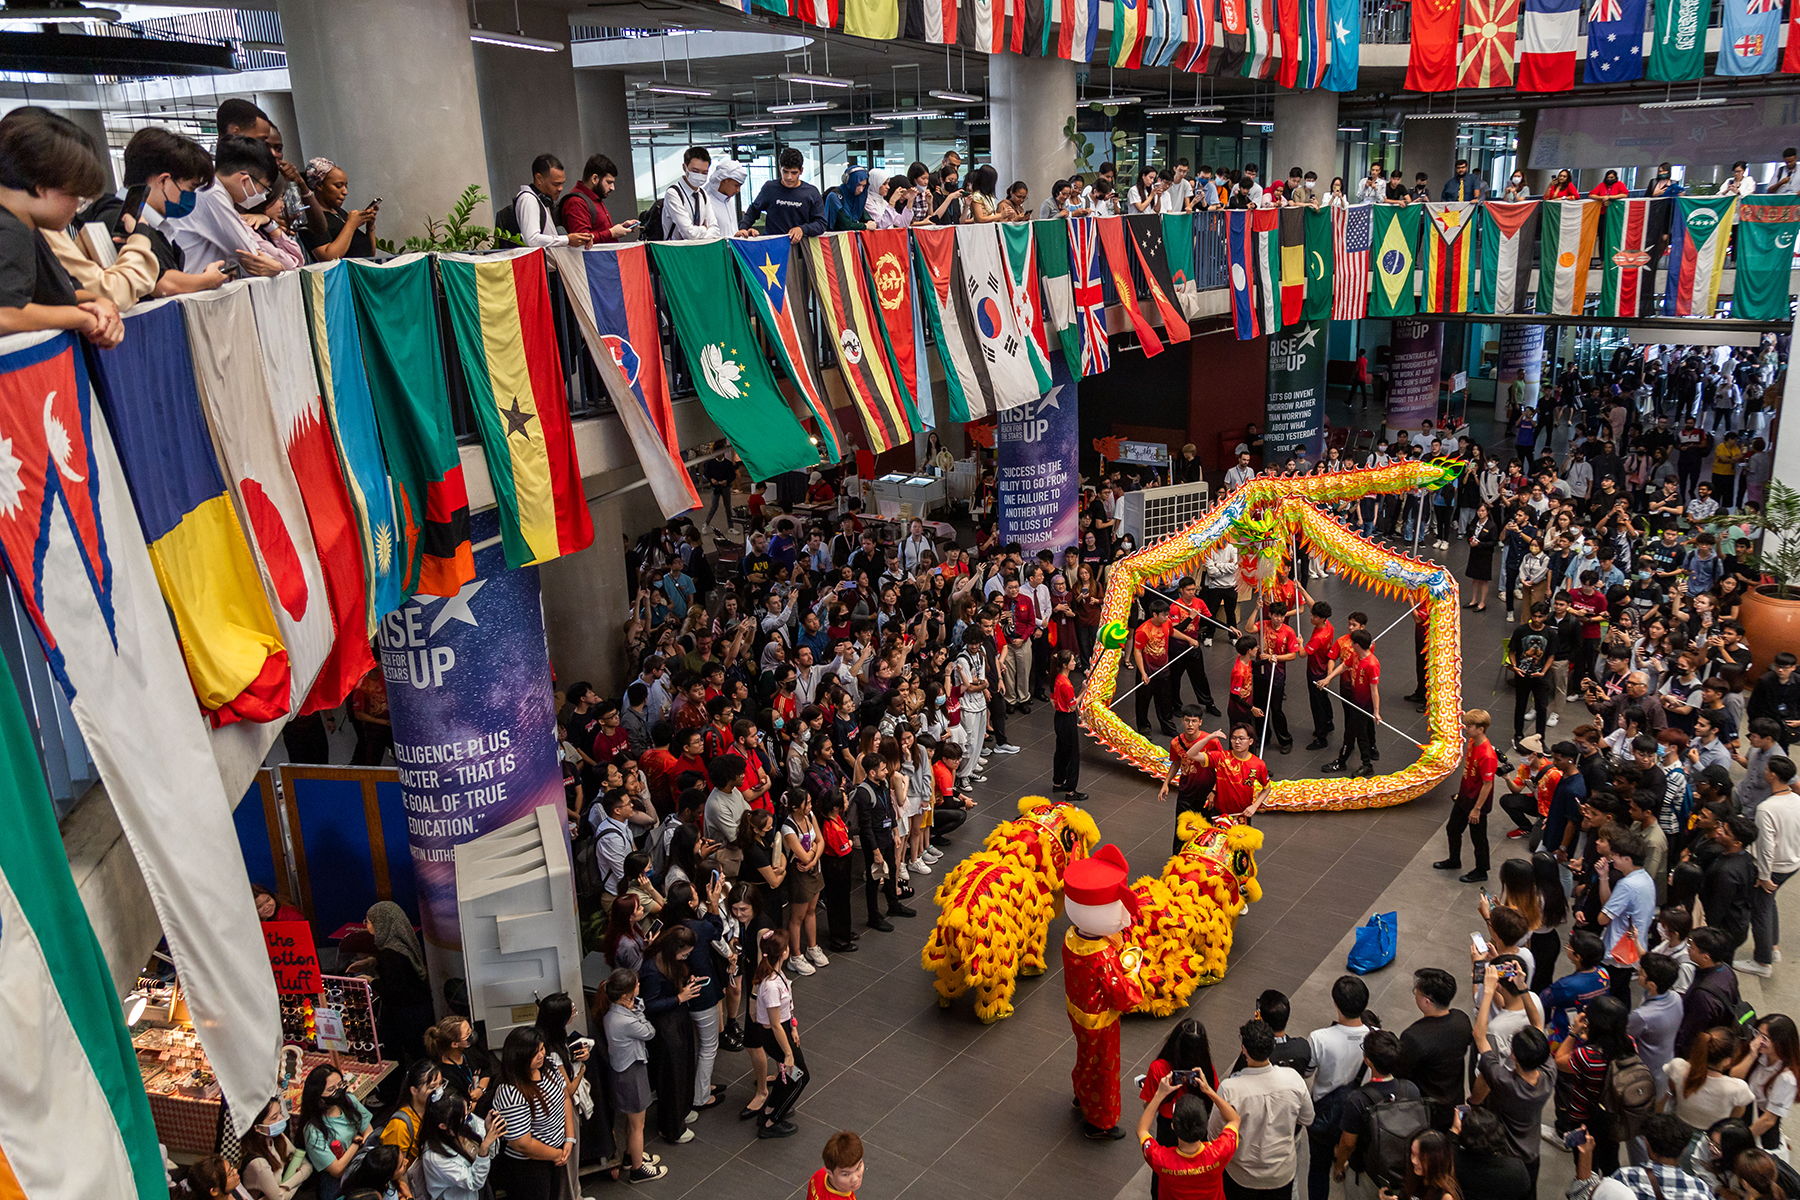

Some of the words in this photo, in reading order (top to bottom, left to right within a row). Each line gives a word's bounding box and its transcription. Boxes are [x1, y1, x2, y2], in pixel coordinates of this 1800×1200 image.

[1412, 324, 1429, 340] UP
[1270, 338, 1297, 357] RISE
[1287, 354, 1306, 371] UP
[1293, 388, 1314, 399] INVENT
[1295, 398, 1316, 409] RATHER
[1001, 403, 1034, 423] RISE
[1281, 409, 1312, 421] WORRYING
[1023, 419, 1048, 443] UP
[1272, 423, 1289, 431] ABOUT
[1290, 420, 1306, 430] WHAT
[1038, 464, 1046, 474] IS
[1048, 460, 1062, 472] THE
[1022, 480, 1031, 490] TO
[1033, 478, 1044, 489] GO
[1046, 472, 1067, 487] FROM
[1004, 494, 1016, 505] ONE
[1017, 491, 1049, 504] FAILURE
[1051, 488, 1060, 499] TO
[1005, 506, 1036, 518] ANOTHER
[1039, 502, 1058, 515] WITH
[1009, 521, 1018, 531] NO
[1020, 519, 1041, 530] LOSS
[1043, 517, 1053, 528] OF
[392, 654, 407, 666] FOR
[408, 646, 455, 689] UP
[388, 667, 409, 680] STARS
[468, 729, 510, 758] PLUS
[455, 760, 495, 785] THAT
[500, 754, 516, 775] IS
[409, 795, 439, 813] GOAL
[441, 793, 460, 812] OF
[464, 782, 508, 809] TRUE
[267, 931, 295, 947] the
[1188, 1165, 1205, 1176] DANCE
